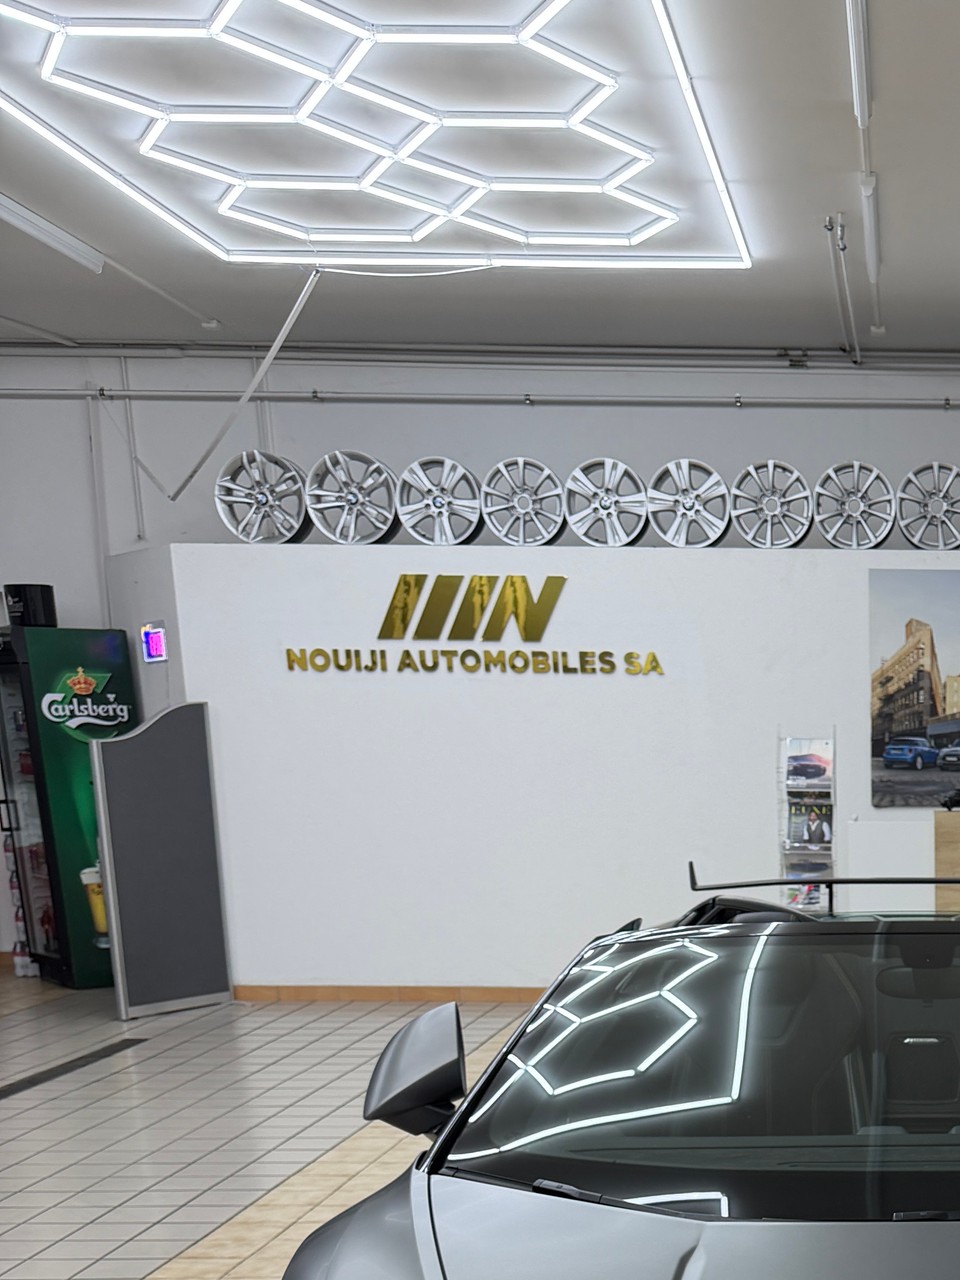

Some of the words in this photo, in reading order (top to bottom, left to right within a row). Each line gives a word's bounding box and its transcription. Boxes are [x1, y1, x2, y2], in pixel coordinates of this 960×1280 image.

[286, 648, 388, 673] NOUIJI
[397, 649, 616, 674] AUTOMOBILES
[623, 651, 665, 675] SA
[41, 692, 130, 727] Carlsberg
